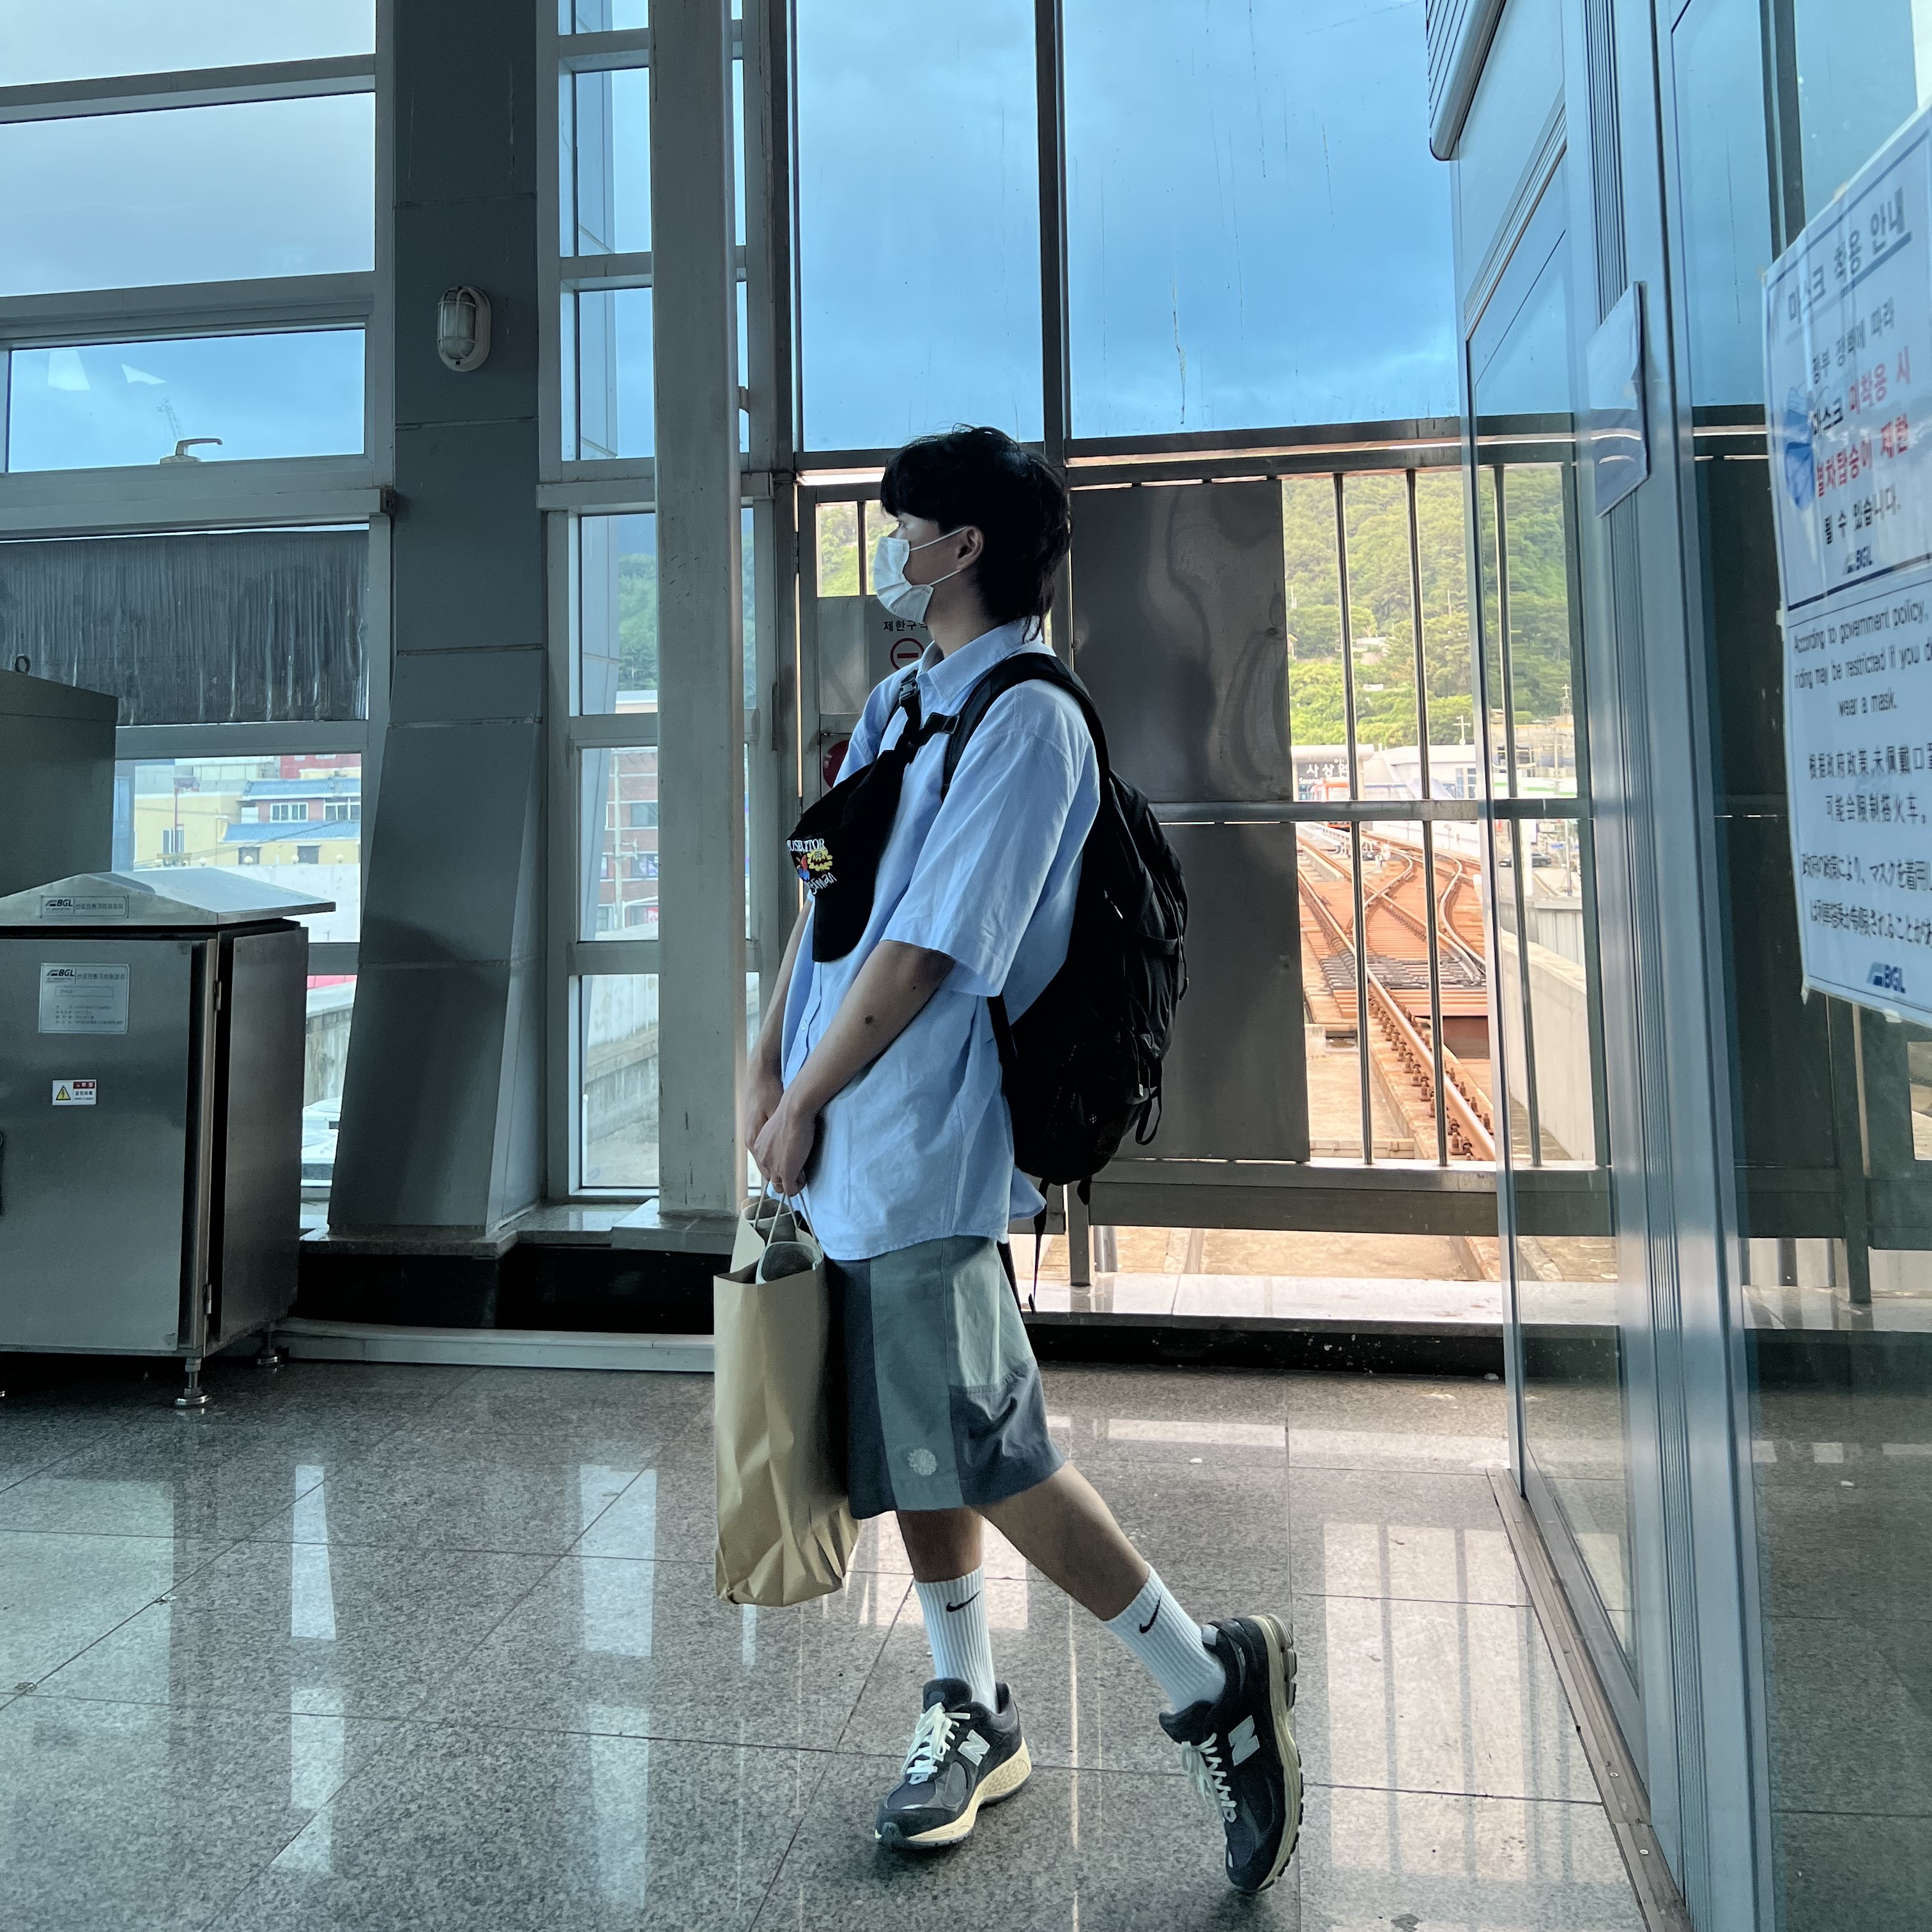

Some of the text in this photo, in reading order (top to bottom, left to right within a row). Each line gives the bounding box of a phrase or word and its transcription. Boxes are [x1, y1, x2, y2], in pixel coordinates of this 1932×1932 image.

[1789, 186, 1905, 325] 마스크 착용 안내
[1812, 348, 1830, 385] 정부
[1849, 362, 1888, 415] 미착용
[1896, 344, 1912, 385] 시
[1880, 413, 1910, 459] 제한
[1837, 509, 1848, 538] 수
[1853, 483, 1902, 531] 있습니다.
[1827, 624, 1837, 645] to
[1839, 606, 1890, 645] government
[1815, 666, 1829, 686] may
[1830, 659, 1843, 681] be
[1845, 647, 1885, 678] restricted
[1899, 645, 1920, 670] you
[1837, 686, 1898, 717] wear a mask.
